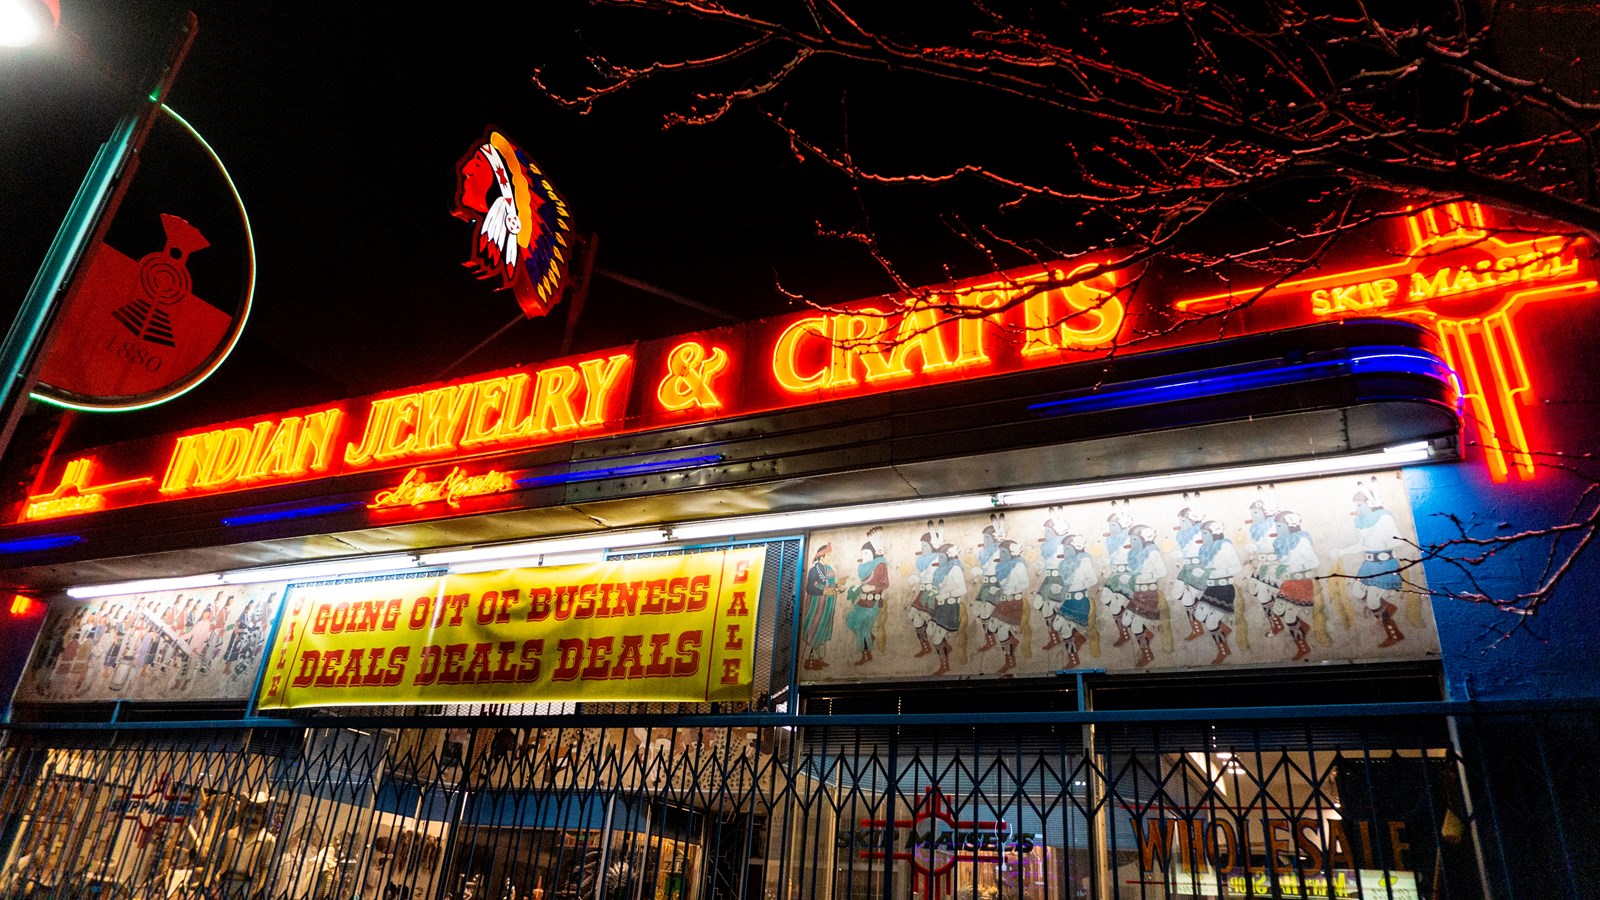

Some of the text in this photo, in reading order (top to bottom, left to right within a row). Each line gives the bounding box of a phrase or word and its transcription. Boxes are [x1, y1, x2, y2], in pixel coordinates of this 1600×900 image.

[1310, 246, 1579, 316] SKIP MAISEL
[106, 336, 163, 373] 1880
[159, 260, 1125, 493] INDIAN JEWELRY & CRAFTS
[312, 575, 711, 635] GOING OUT OF BUSINESS
[720, 560, 750, 685] SALE
[267, 597, 306, 697] SALE
[291, 630, 704, 688] DEALS DEALS DEALS
